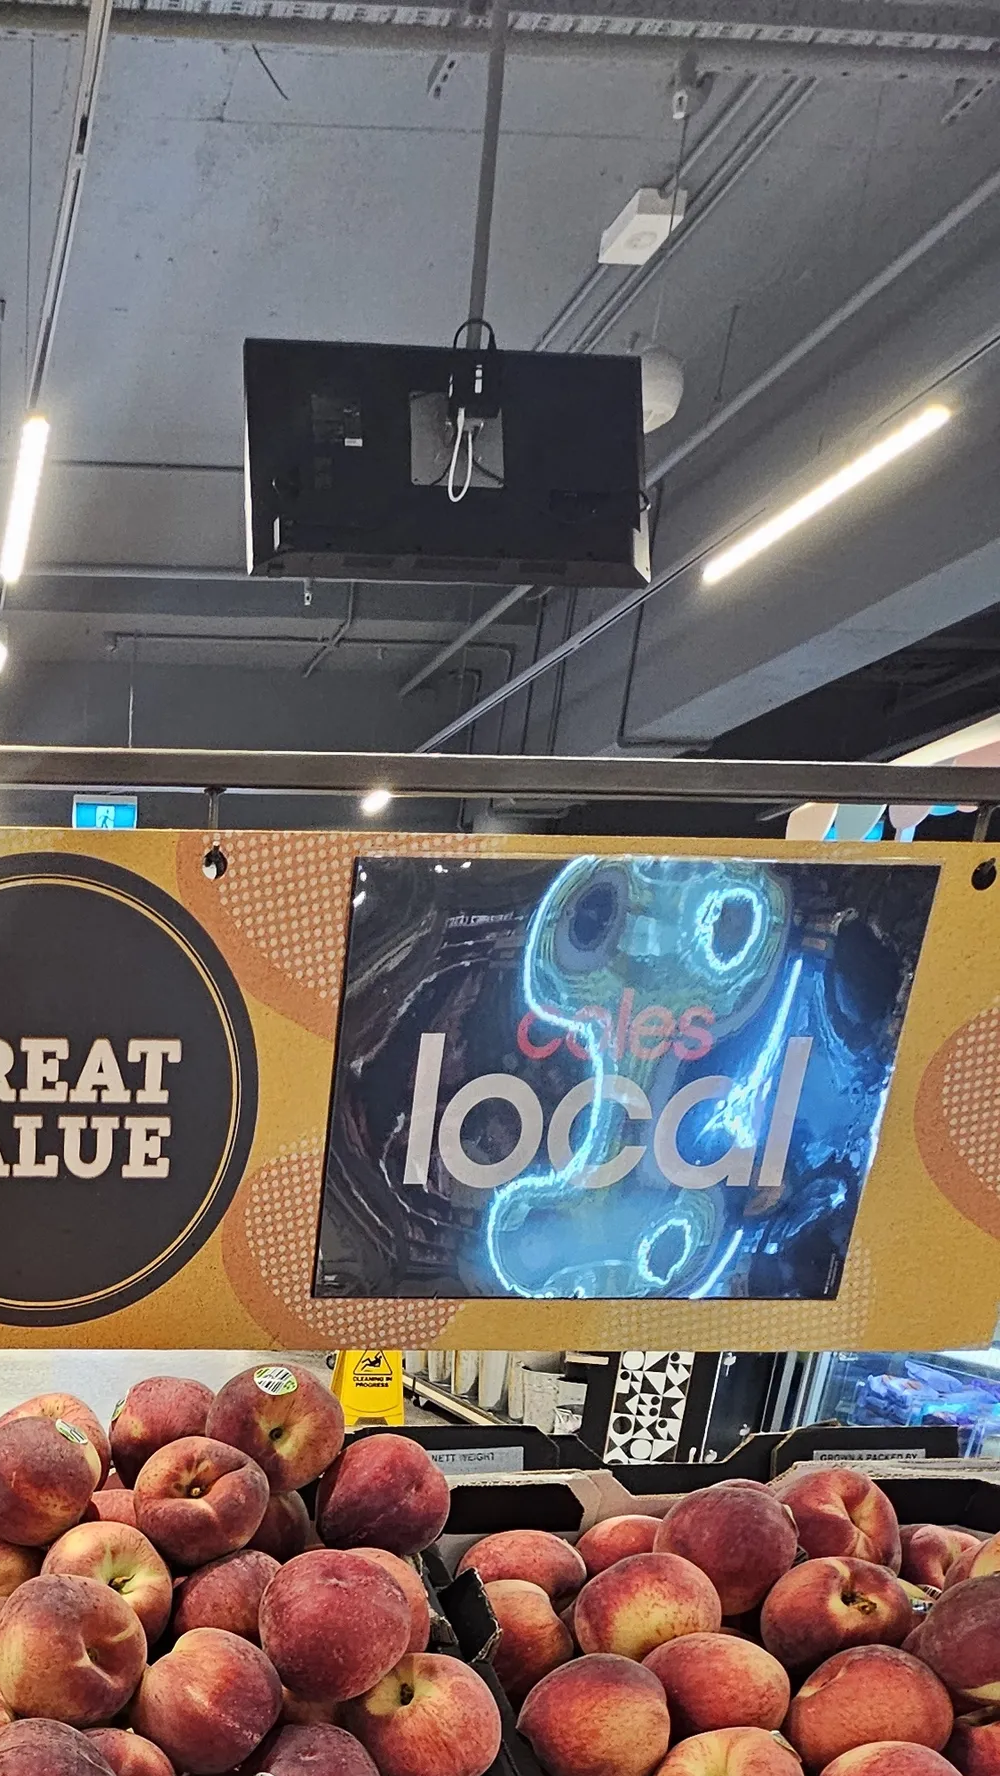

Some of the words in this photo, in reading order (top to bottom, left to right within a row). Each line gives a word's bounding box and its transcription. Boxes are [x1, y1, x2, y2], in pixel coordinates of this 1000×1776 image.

[516, 987, 717, 1061] coles
[402, 1032, 813, 1190] local
[431, 1453, 456, 1463] NETT
[462, 1452, 495, 1462] WEIGHT
